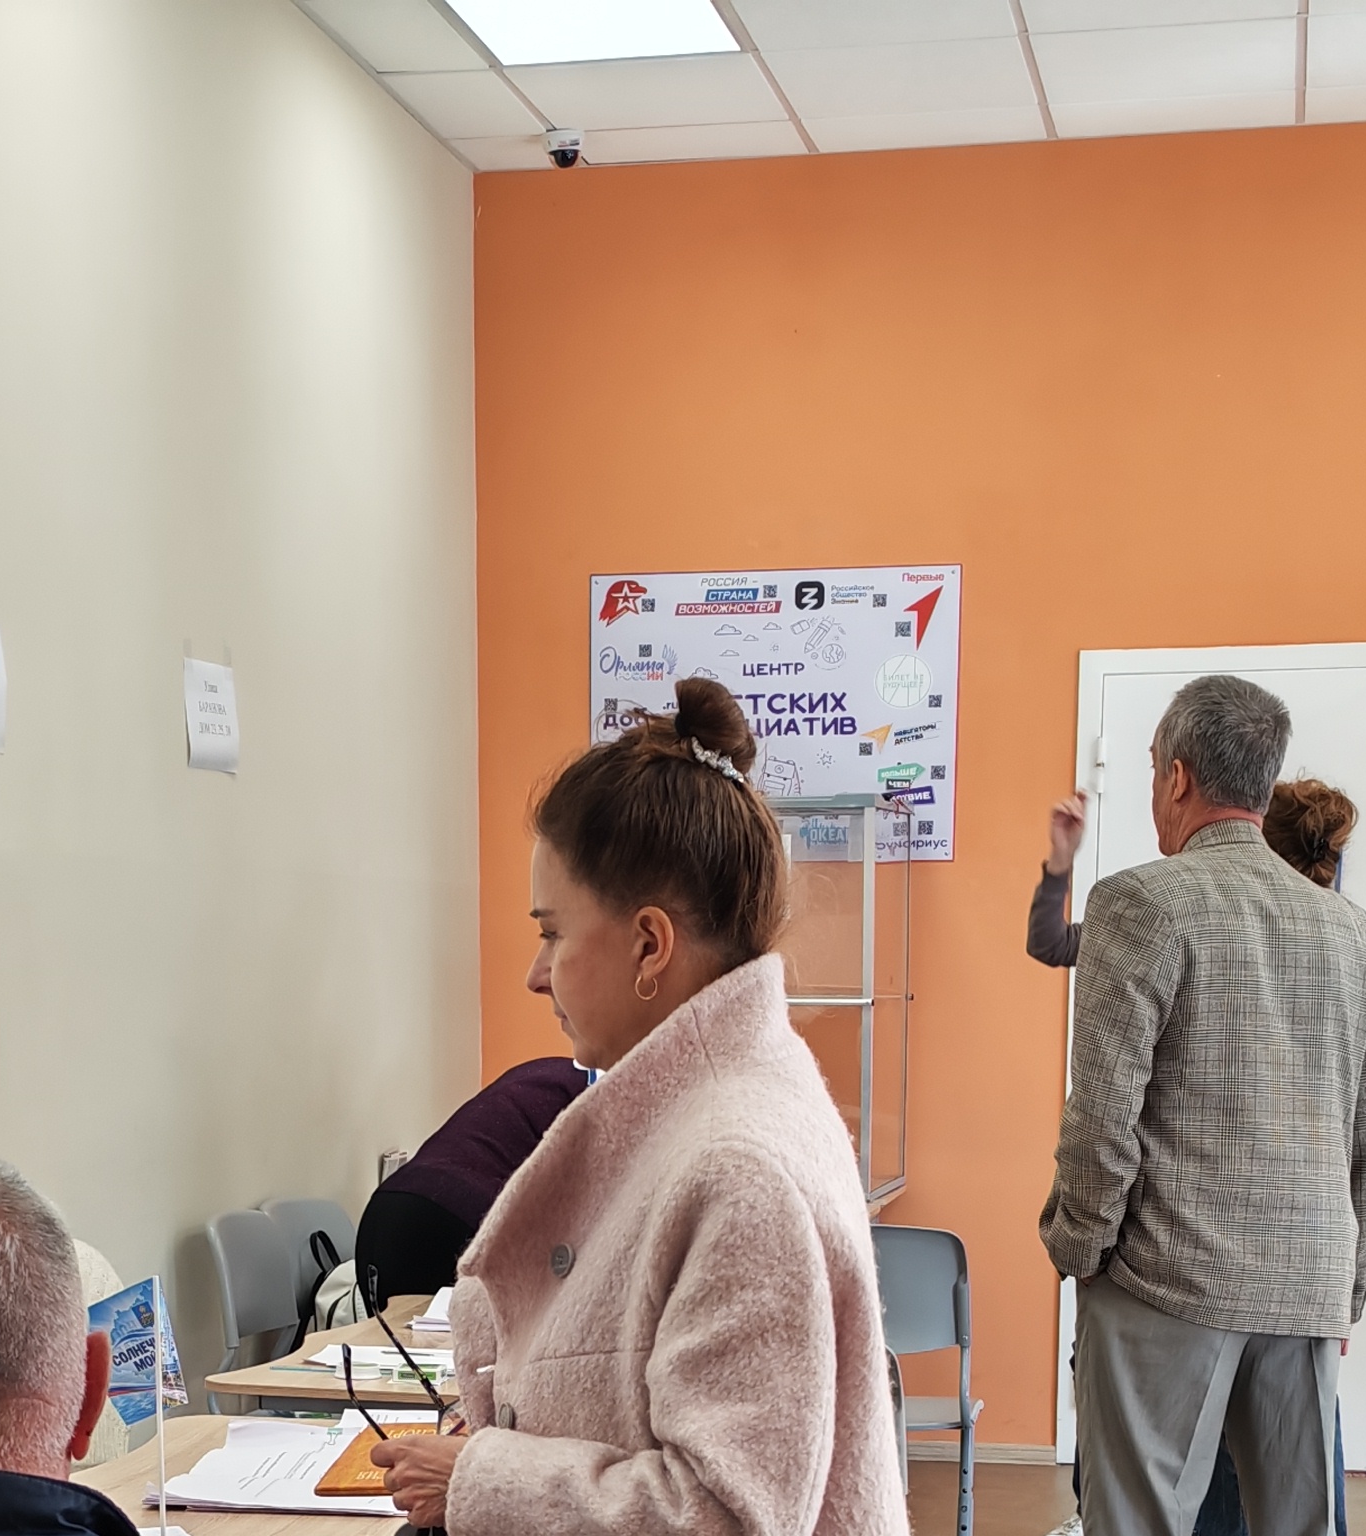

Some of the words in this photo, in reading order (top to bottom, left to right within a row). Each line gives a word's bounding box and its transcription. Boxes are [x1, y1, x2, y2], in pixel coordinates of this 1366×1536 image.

[700, 576, 748, 587] РОССИЯ
[902, 572, 945, 584] Первые
[831, 584, 875, 592] Российское
[708, 590, 754, 601] СТРАНА
[678, 602, 776, 614] ВОЗМОЖНОСТЕЙ
[742, 662, 805, 678] ЦЕНТР
[732, 692, 847, 715] ТСКИХ
[746, 717, 858, 739] ЦИАТИВ
[809, 826, 848, 842] ОКЕА
[910, 838, 948, 850] ириус
